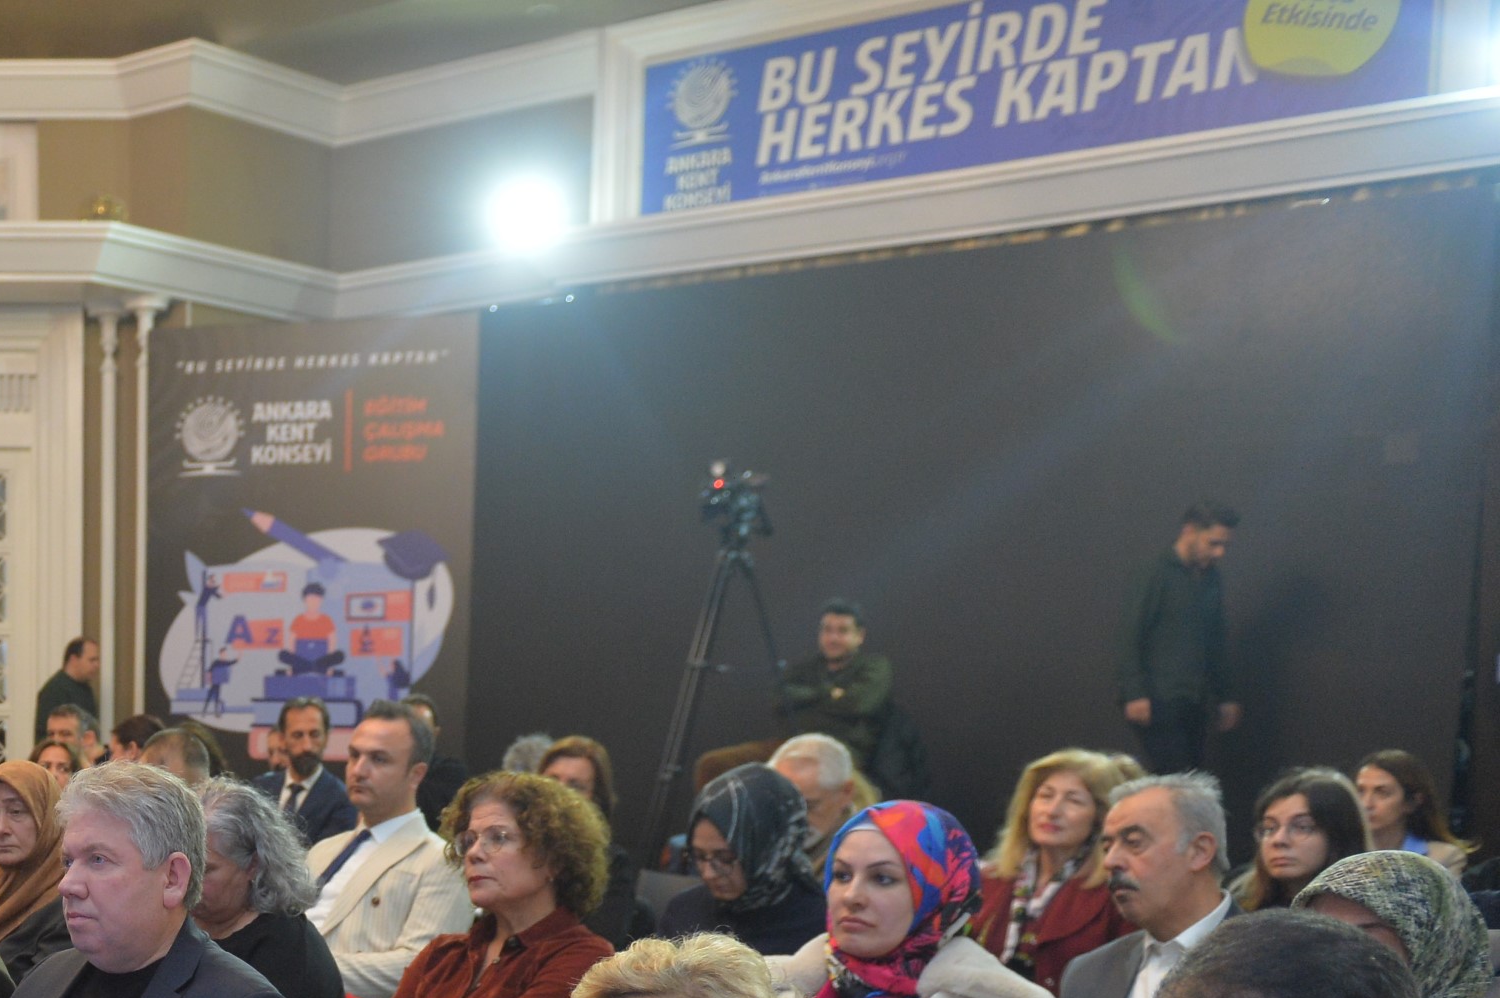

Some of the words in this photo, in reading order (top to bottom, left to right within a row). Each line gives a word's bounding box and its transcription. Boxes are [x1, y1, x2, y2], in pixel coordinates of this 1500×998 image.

[1261, 2, 1379, 31] Etkisinde
[757, 47, 838, 113] BU
[850, 0, 1104, 96] SEYİRDE
[755, 74, 977, 168] HERKES
[992, 27, 1258, 128] KAPTAN
[251, 399, 333, 422] ANKARA
[265, 421, 318, 443] KENT
[251, 438, 333, 465] KONSEYİ
